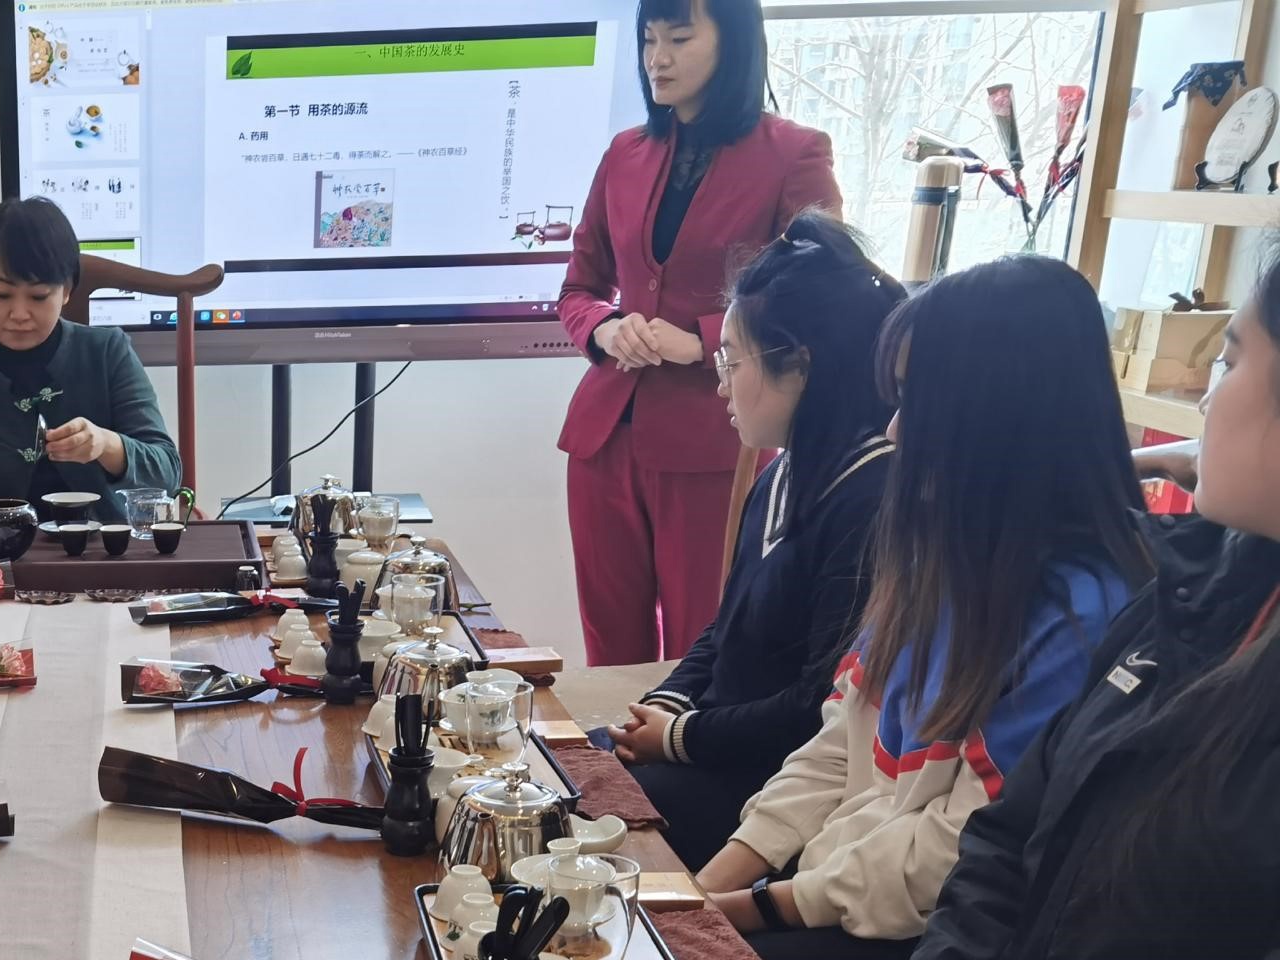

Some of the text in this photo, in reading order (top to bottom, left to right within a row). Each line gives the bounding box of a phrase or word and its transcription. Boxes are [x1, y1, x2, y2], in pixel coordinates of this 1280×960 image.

[354, 43, 465, 59] 一、中国茶的发展史
[264, 102, 369, 118] 第一节 用茶的源流
[250, 131, 269, 141] 药用
